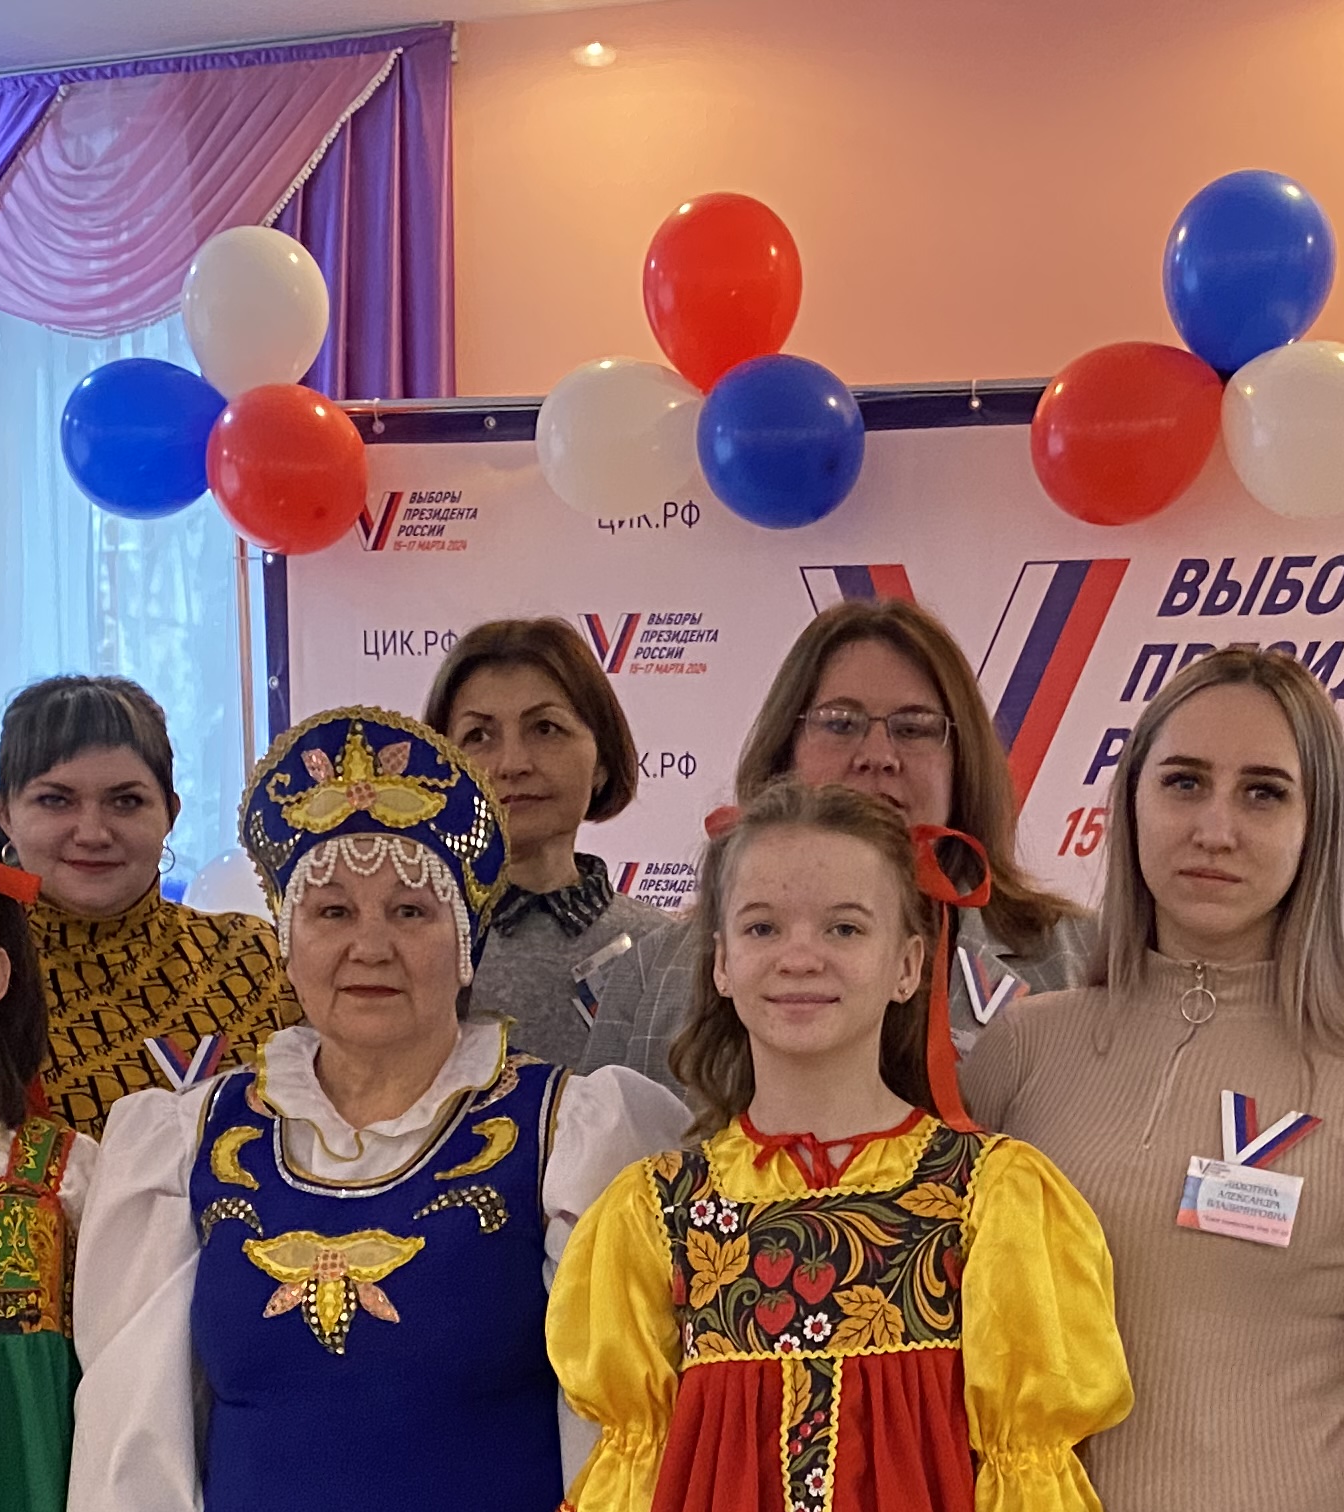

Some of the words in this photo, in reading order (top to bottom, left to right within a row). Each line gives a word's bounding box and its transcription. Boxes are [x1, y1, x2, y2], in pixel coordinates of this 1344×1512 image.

[409, 490, 462, 504] ВЫБОРЫ
[403, 508, 478, 521] ПРЕЗИДЕНТА
[397, 524, 446, 537] РОССИИ
[647, 612, 702, 625] ВЫБОРЫ
[640, 629, 719, 644] ПРЕЗИДЕНТА
[363, 629, 458, 661] ЦИК.РФ
[634, 647, 684, 659] РОССИИ
[638, 879, 699, 893] ПРЕЗИДЕ
